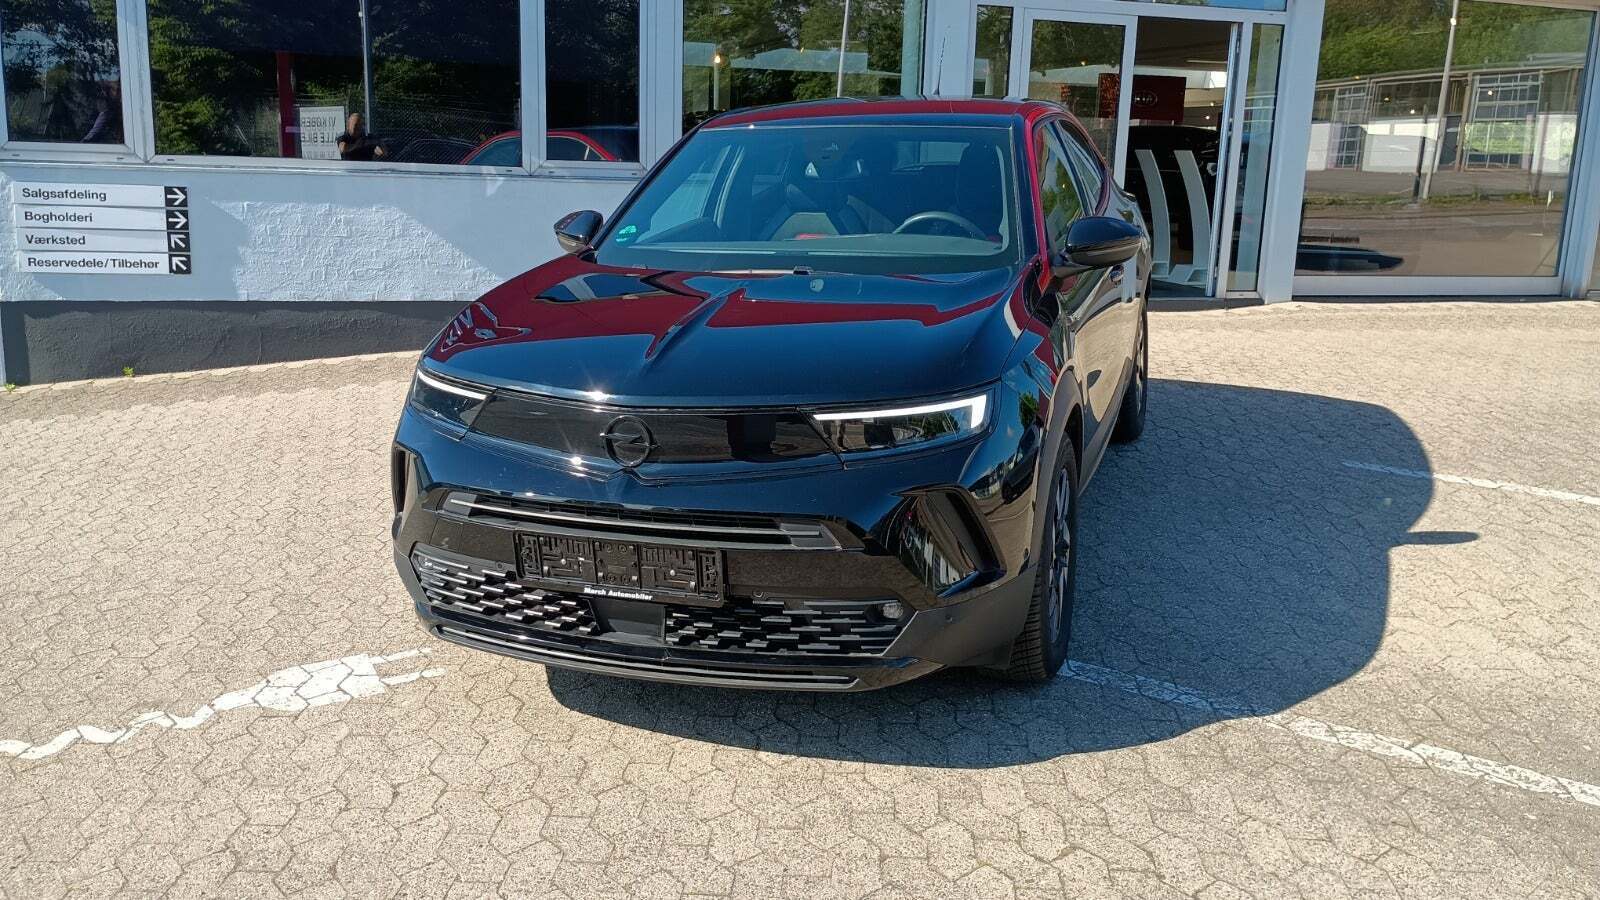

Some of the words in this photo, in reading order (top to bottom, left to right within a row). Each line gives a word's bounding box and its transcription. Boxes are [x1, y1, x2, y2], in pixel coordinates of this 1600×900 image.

[22, 187, 107, 202] Salgsafdeling
[24, 211, 93, 223] Bogholderi
[25, 234, 86, 245] Værksted
[27, 257, 160, 269] Reservedele/Tilbehør
[608, 590, 653, 600] Automobiler
